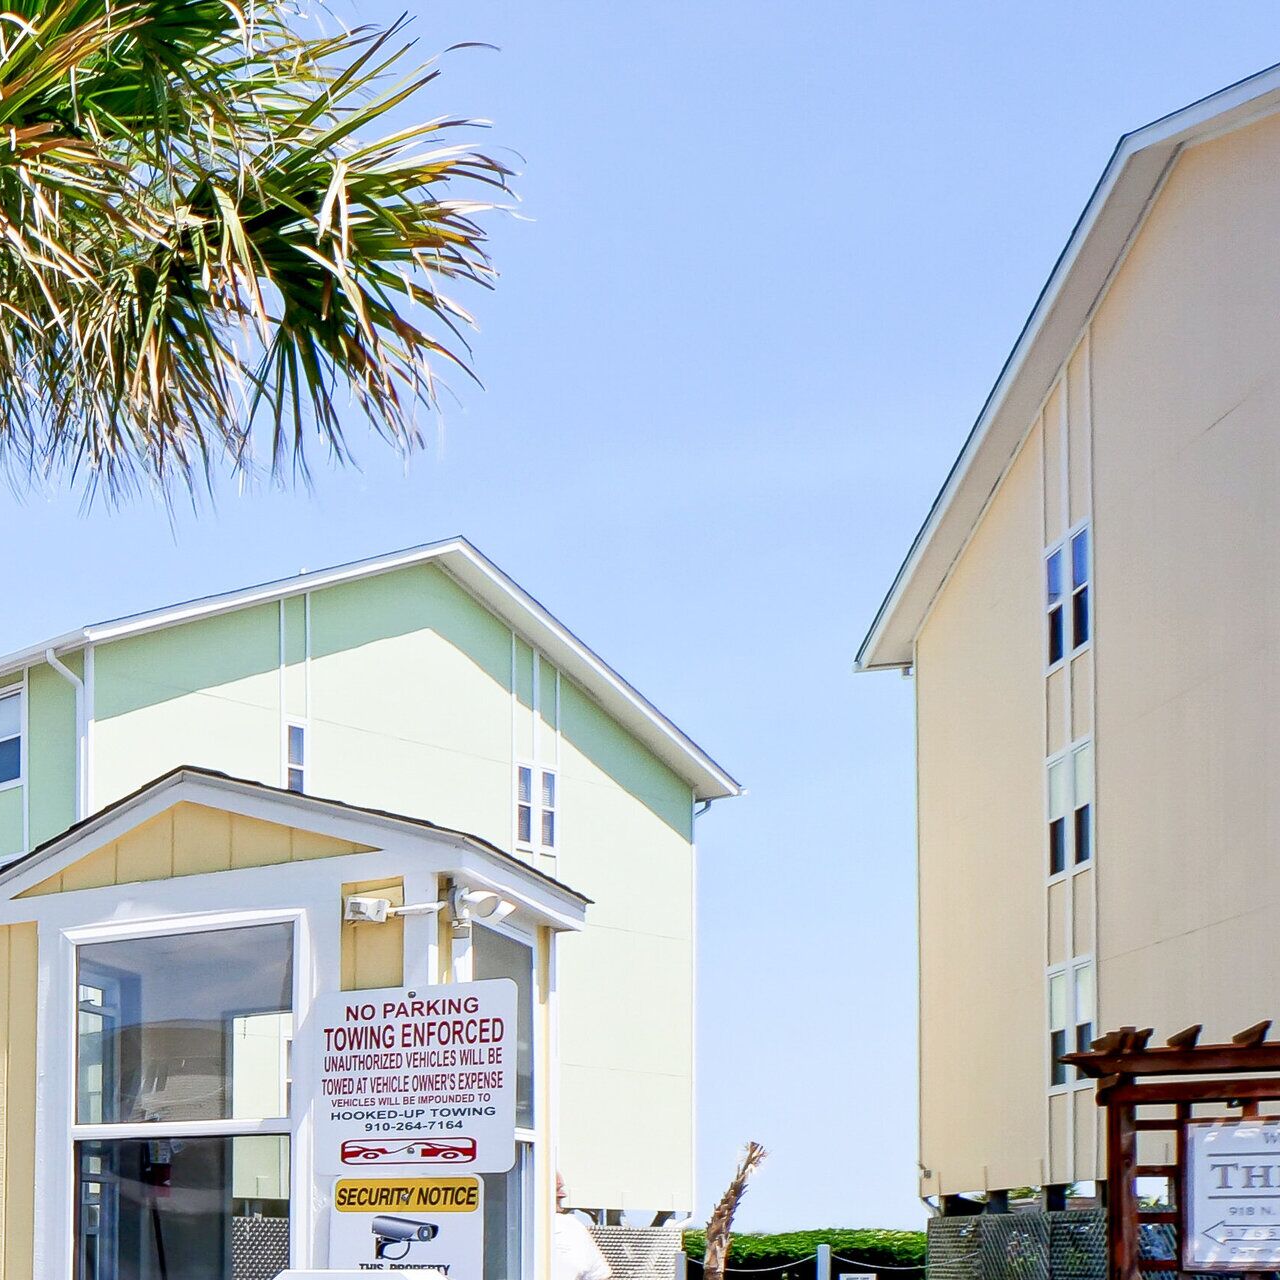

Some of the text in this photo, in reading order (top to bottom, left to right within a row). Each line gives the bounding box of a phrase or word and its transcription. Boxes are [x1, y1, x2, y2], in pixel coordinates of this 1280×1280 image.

[345, 997, 479, 1021] NO PARKING
[324, 1018, 505, 1052] TOWING ENFORCED
[324, 1047, 503, 1072] UNAUTHORIZED VEHICLES WILL BE
[322, 1071, 503, 1096] TOWED AT VEHICLE OWNER'S EXPENSE
[331, 1093, 491, 1107] VEHICLES WILL BE IMPOUNDED TO
[331, 1106, 496, 1121] HOOKED-UP TOWING
[365, 1120, 463, 1132] 910-264-7164
[337, 1186, 478, 1206] SECURITY NOTICE
